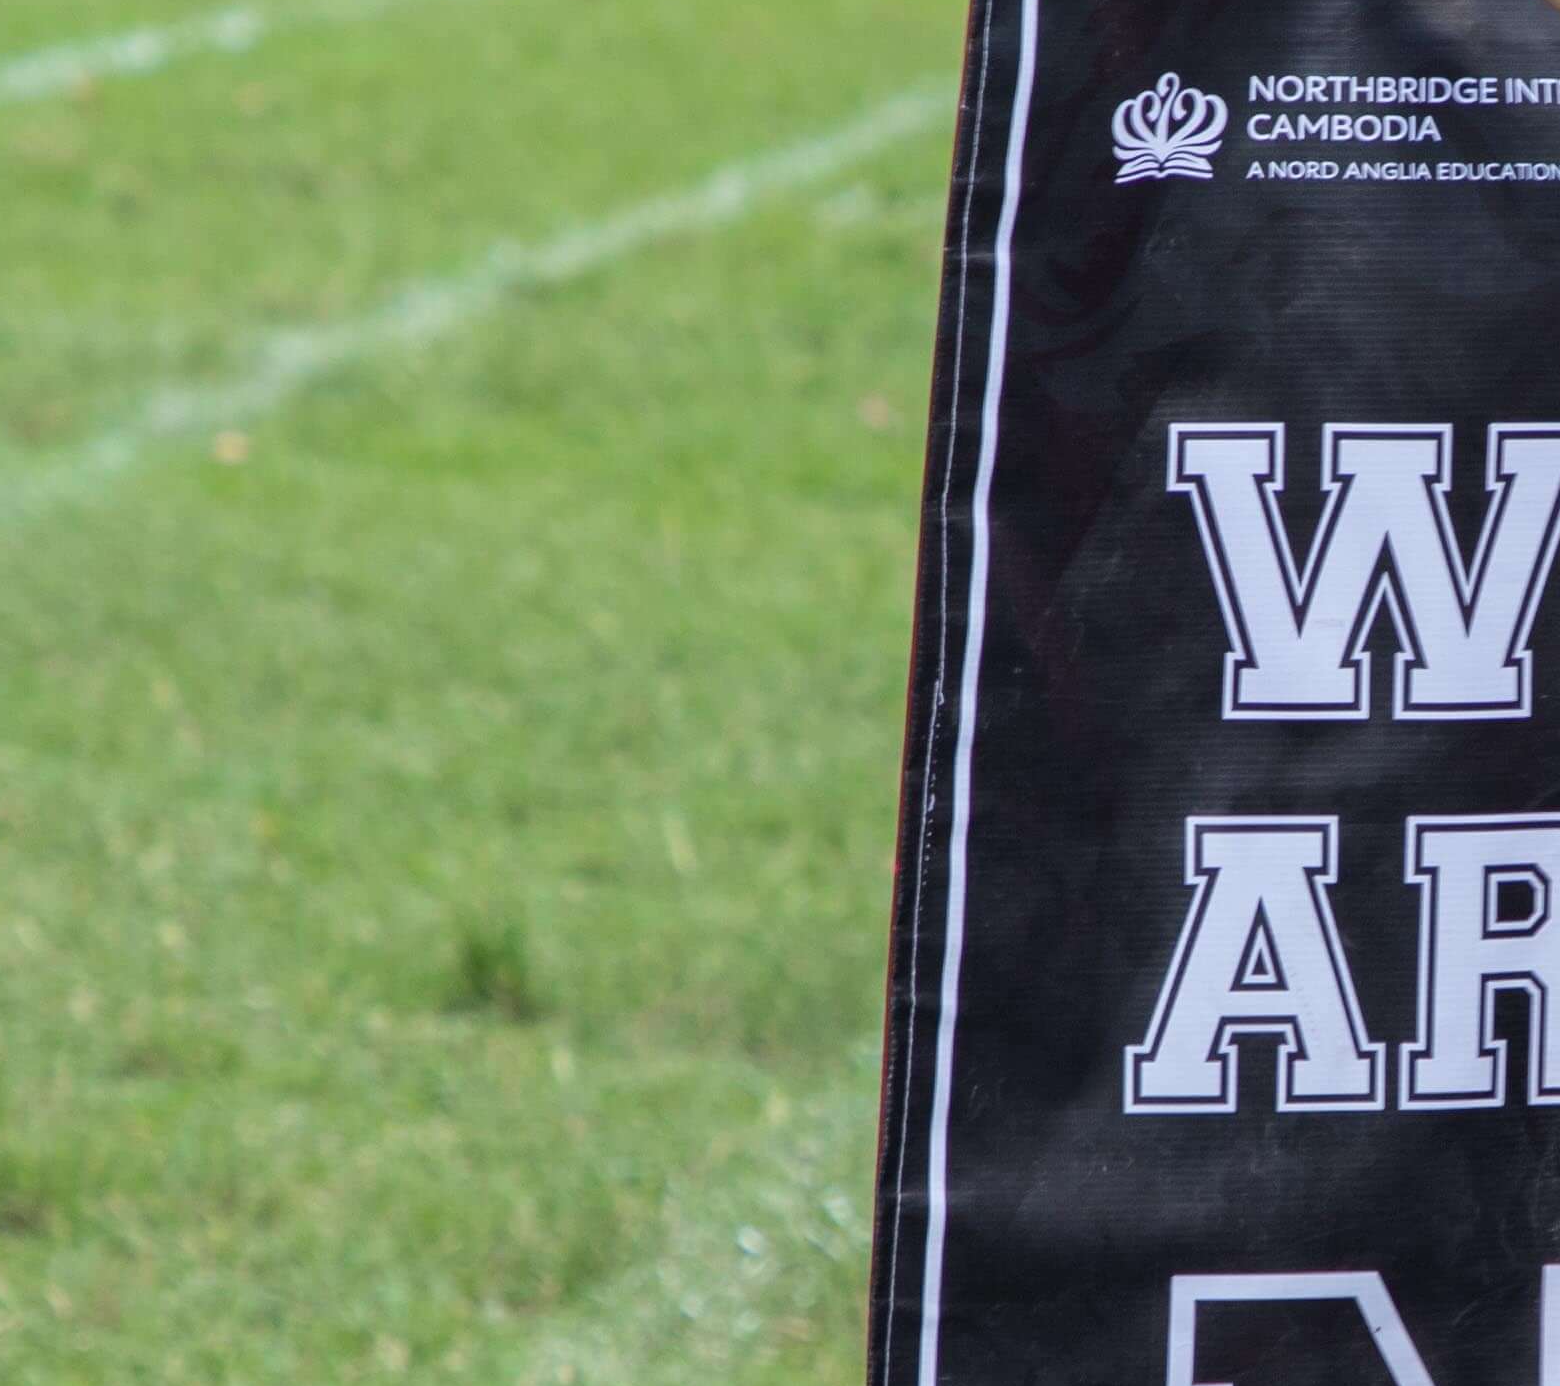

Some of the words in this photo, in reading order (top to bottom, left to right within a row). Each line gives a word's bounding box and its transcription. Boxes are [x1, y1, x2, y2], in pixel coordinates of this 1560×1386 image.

[1248, 75, 1499, 104] NORTHBRIDGE
[1246, 114, 1442, 142] CAMBODIA
[1246, 161, 1264, 179] A
[1269, 161, 1339, 180] NORD
[1343, 162, 1431, 181] ANGLIA
